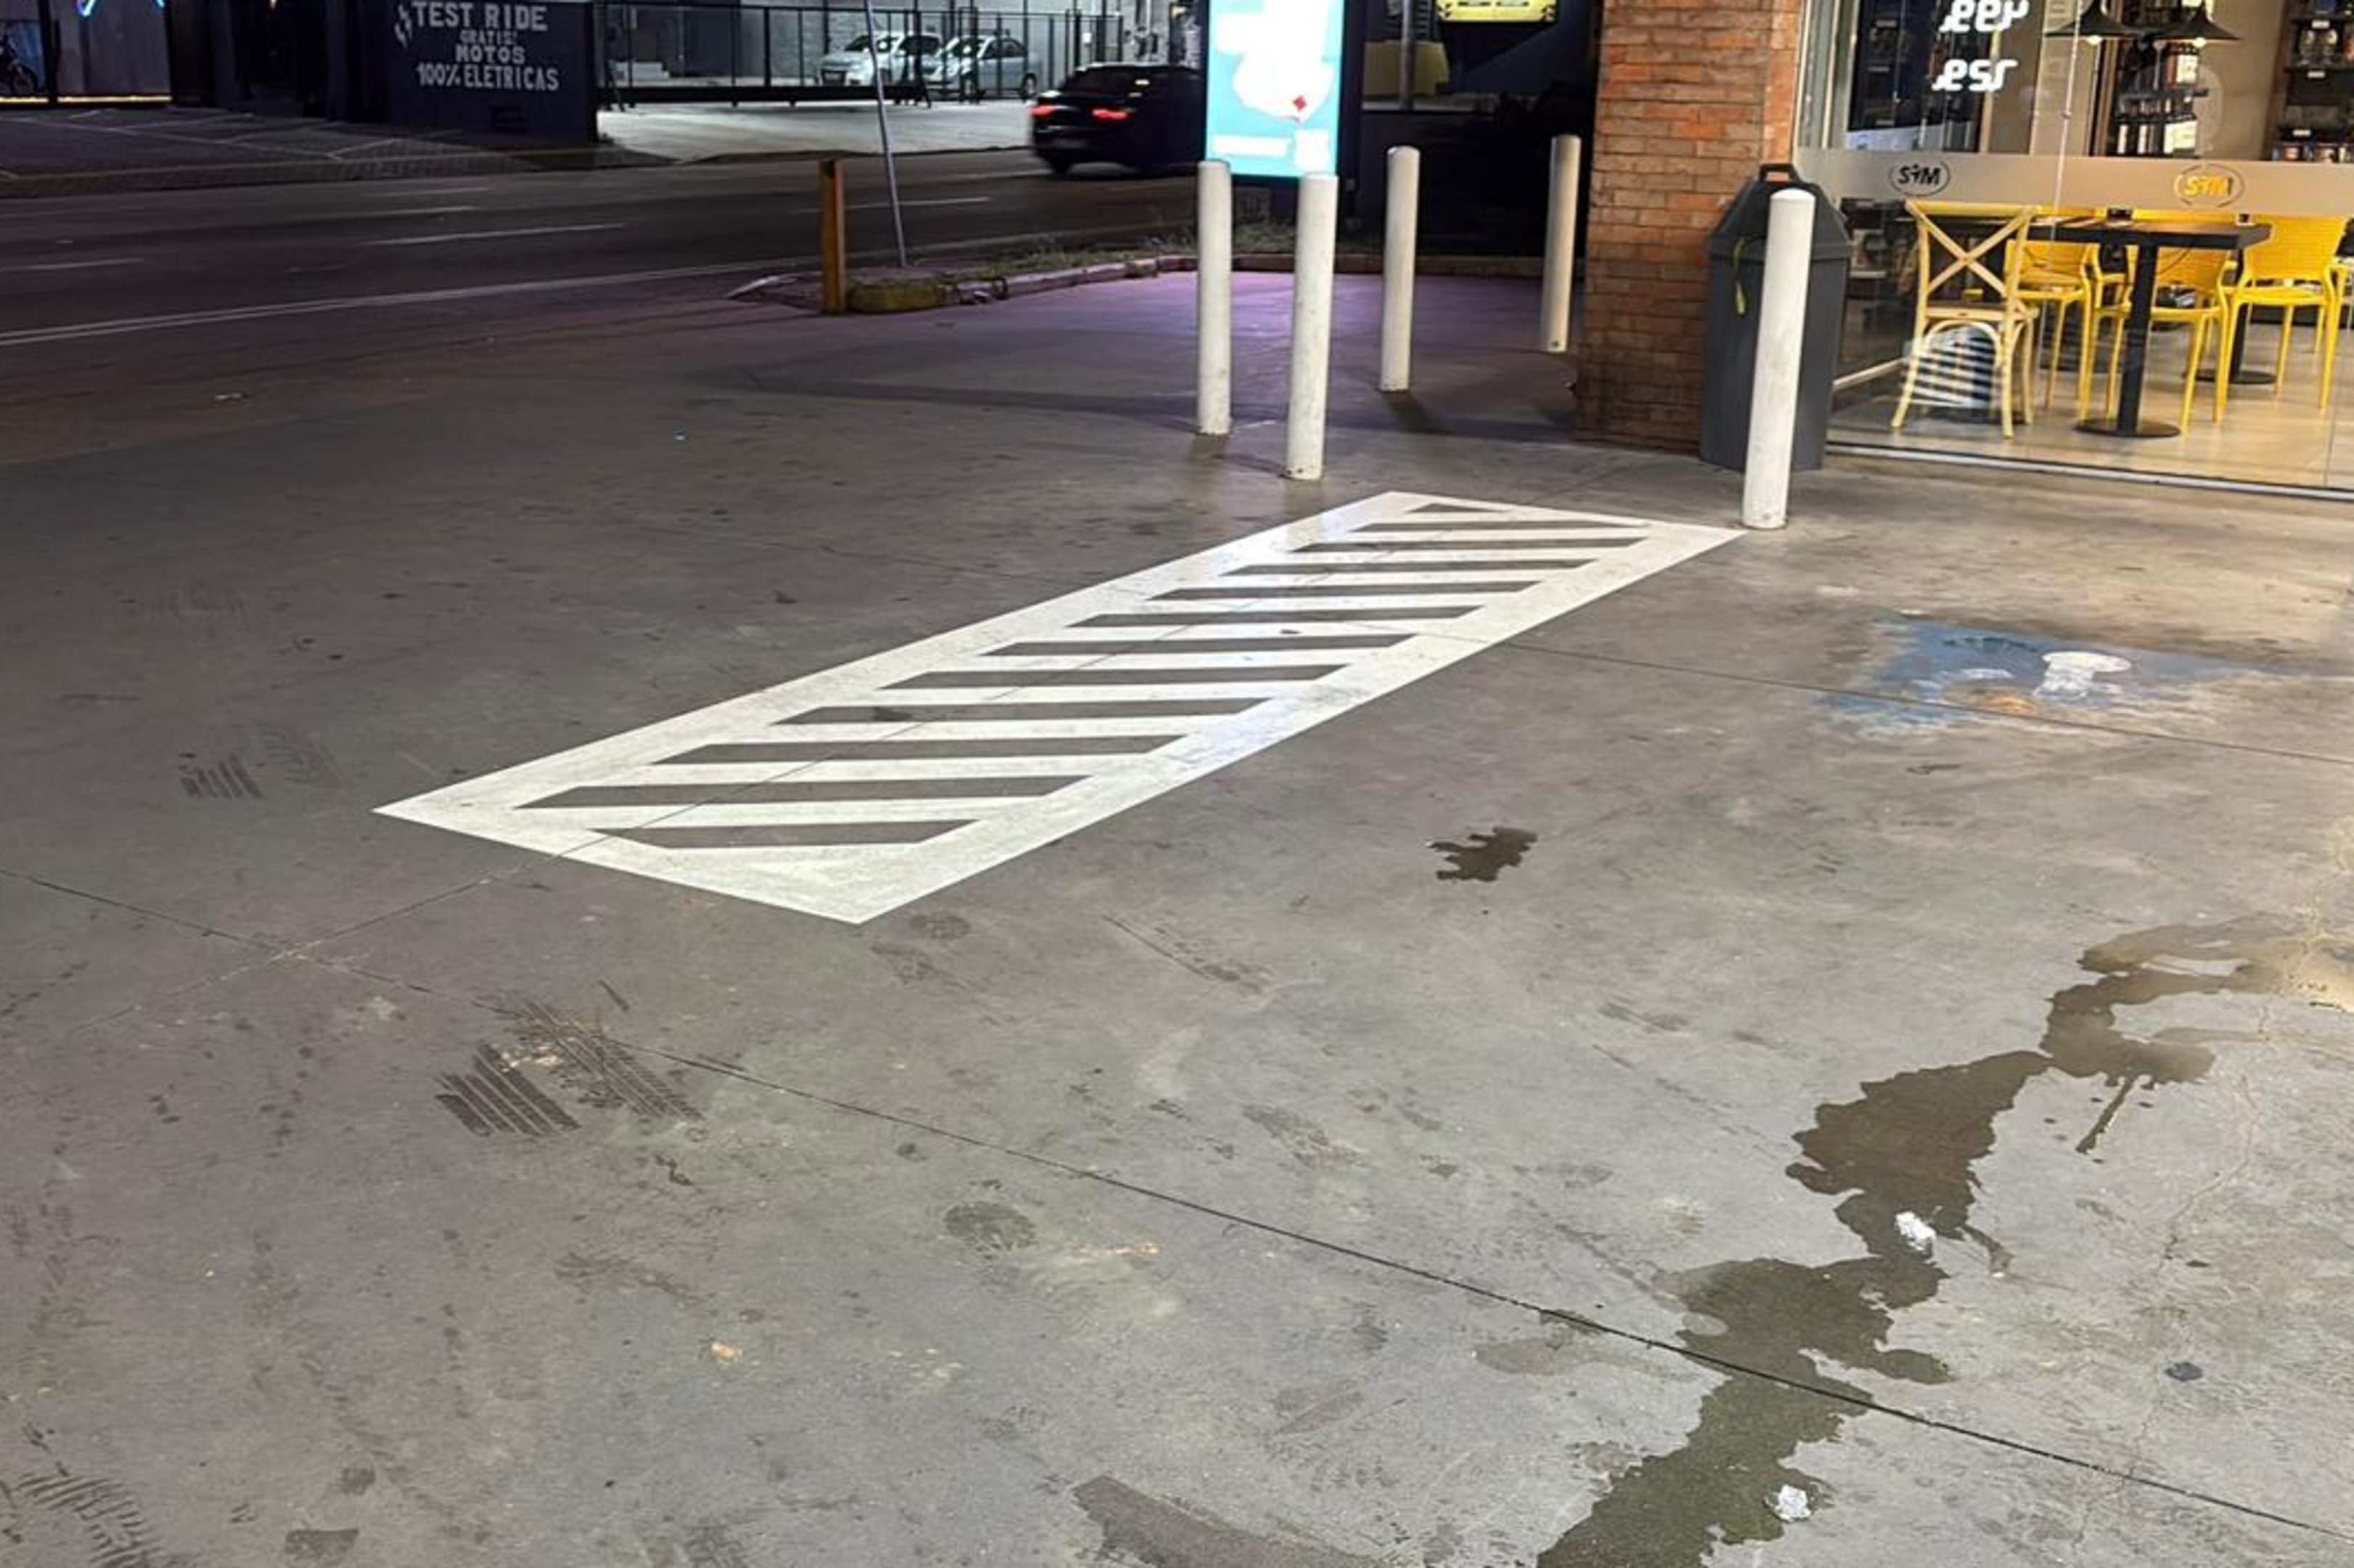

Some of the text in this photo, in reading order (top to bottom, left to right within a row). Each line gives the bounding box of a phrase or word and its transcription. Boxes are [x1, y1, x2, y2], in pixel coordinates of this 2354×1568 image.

[412, 1, 549, 31] TEST RIDE
[455, 44, 526, 65] MOTOS
[417, 62, 560, 91] 100% ELETRICAS
